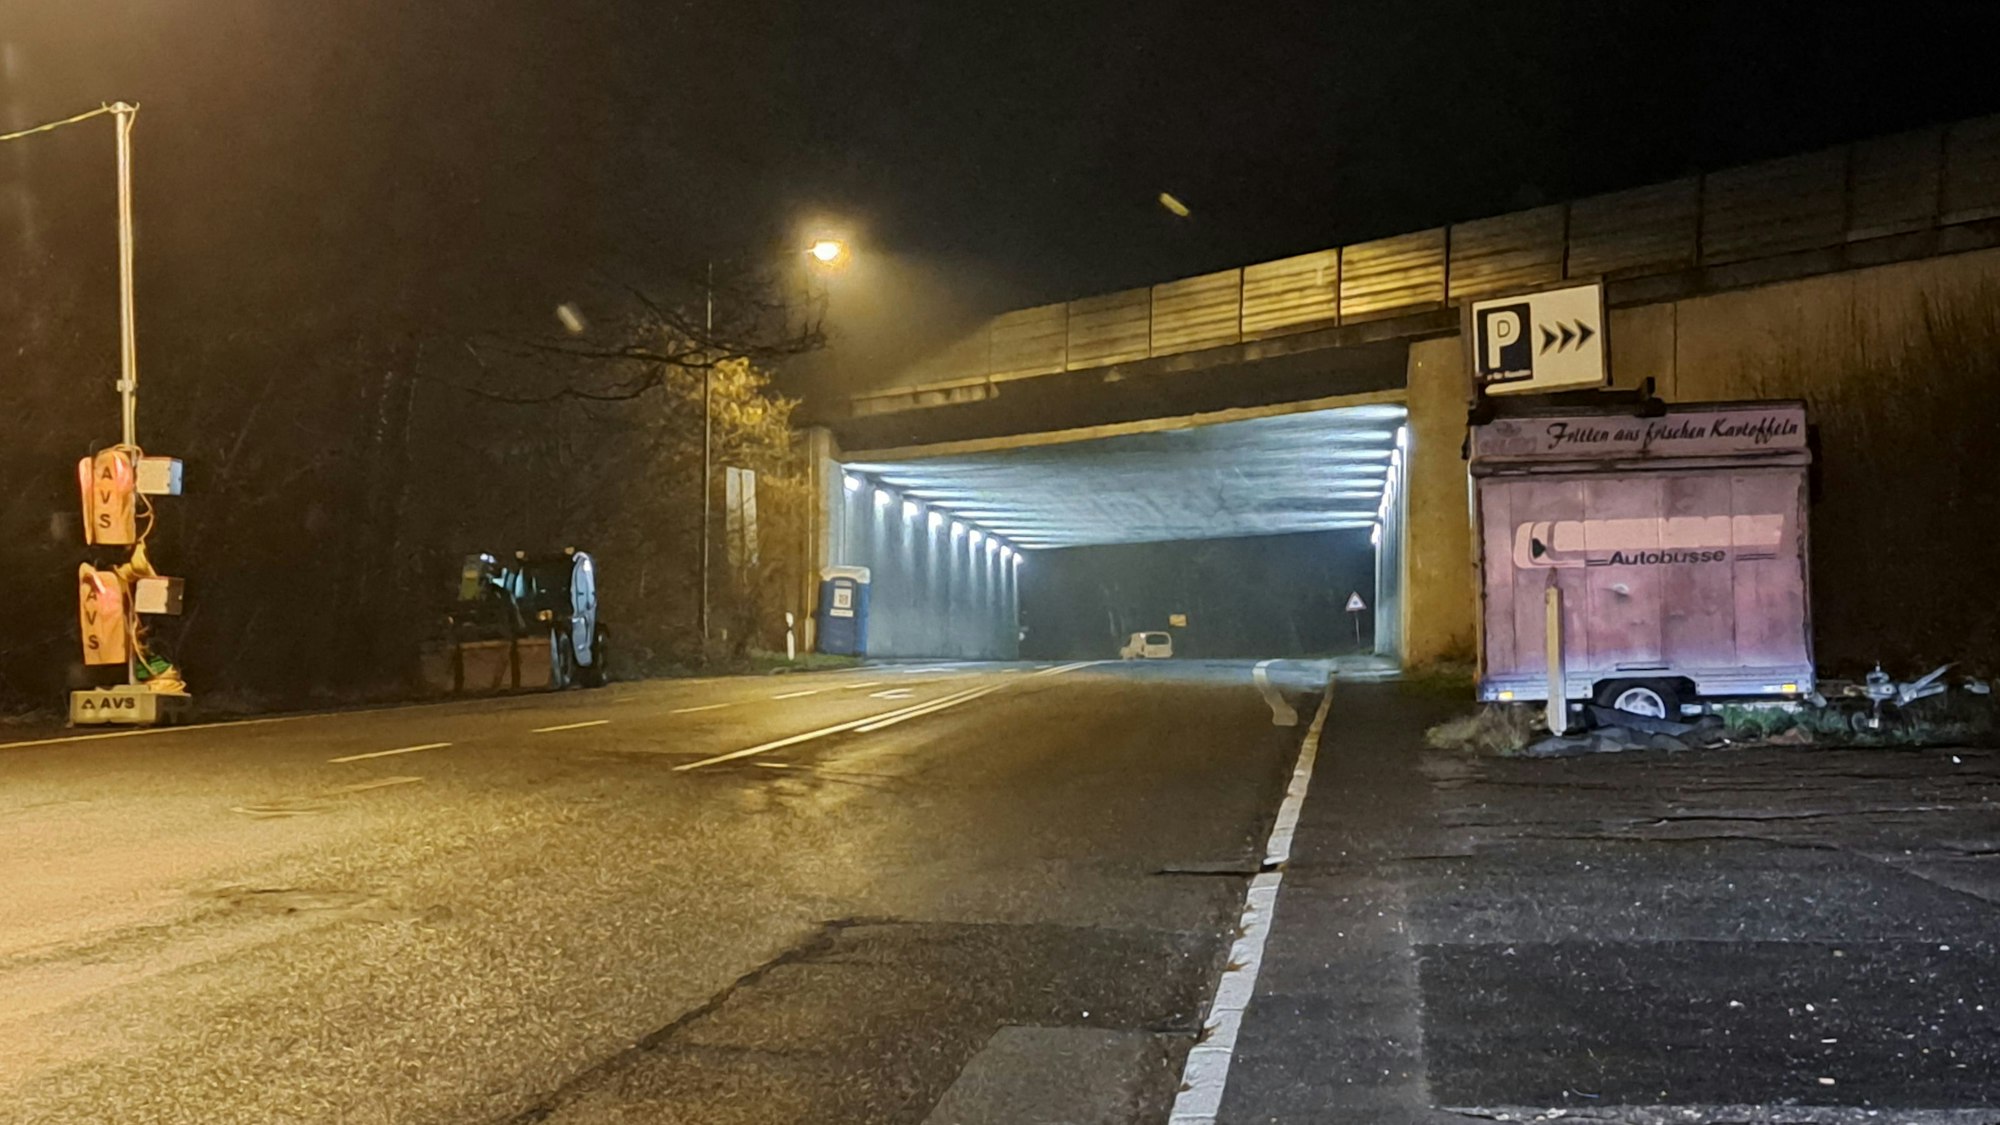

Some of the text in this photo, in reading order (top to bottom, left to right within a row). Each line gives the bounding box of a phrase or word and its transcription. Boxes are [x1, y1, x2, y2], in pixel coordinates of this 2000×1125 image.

[1486, 310, 1521, 369] P
[1546, 417, 1798, 449] Fritten aus frischen Kartoffeln
[99, 466, 113, 529] AVS
[1609, 550, 1726, 566] Autobusse
[100, 697, 136, 709] AVS
